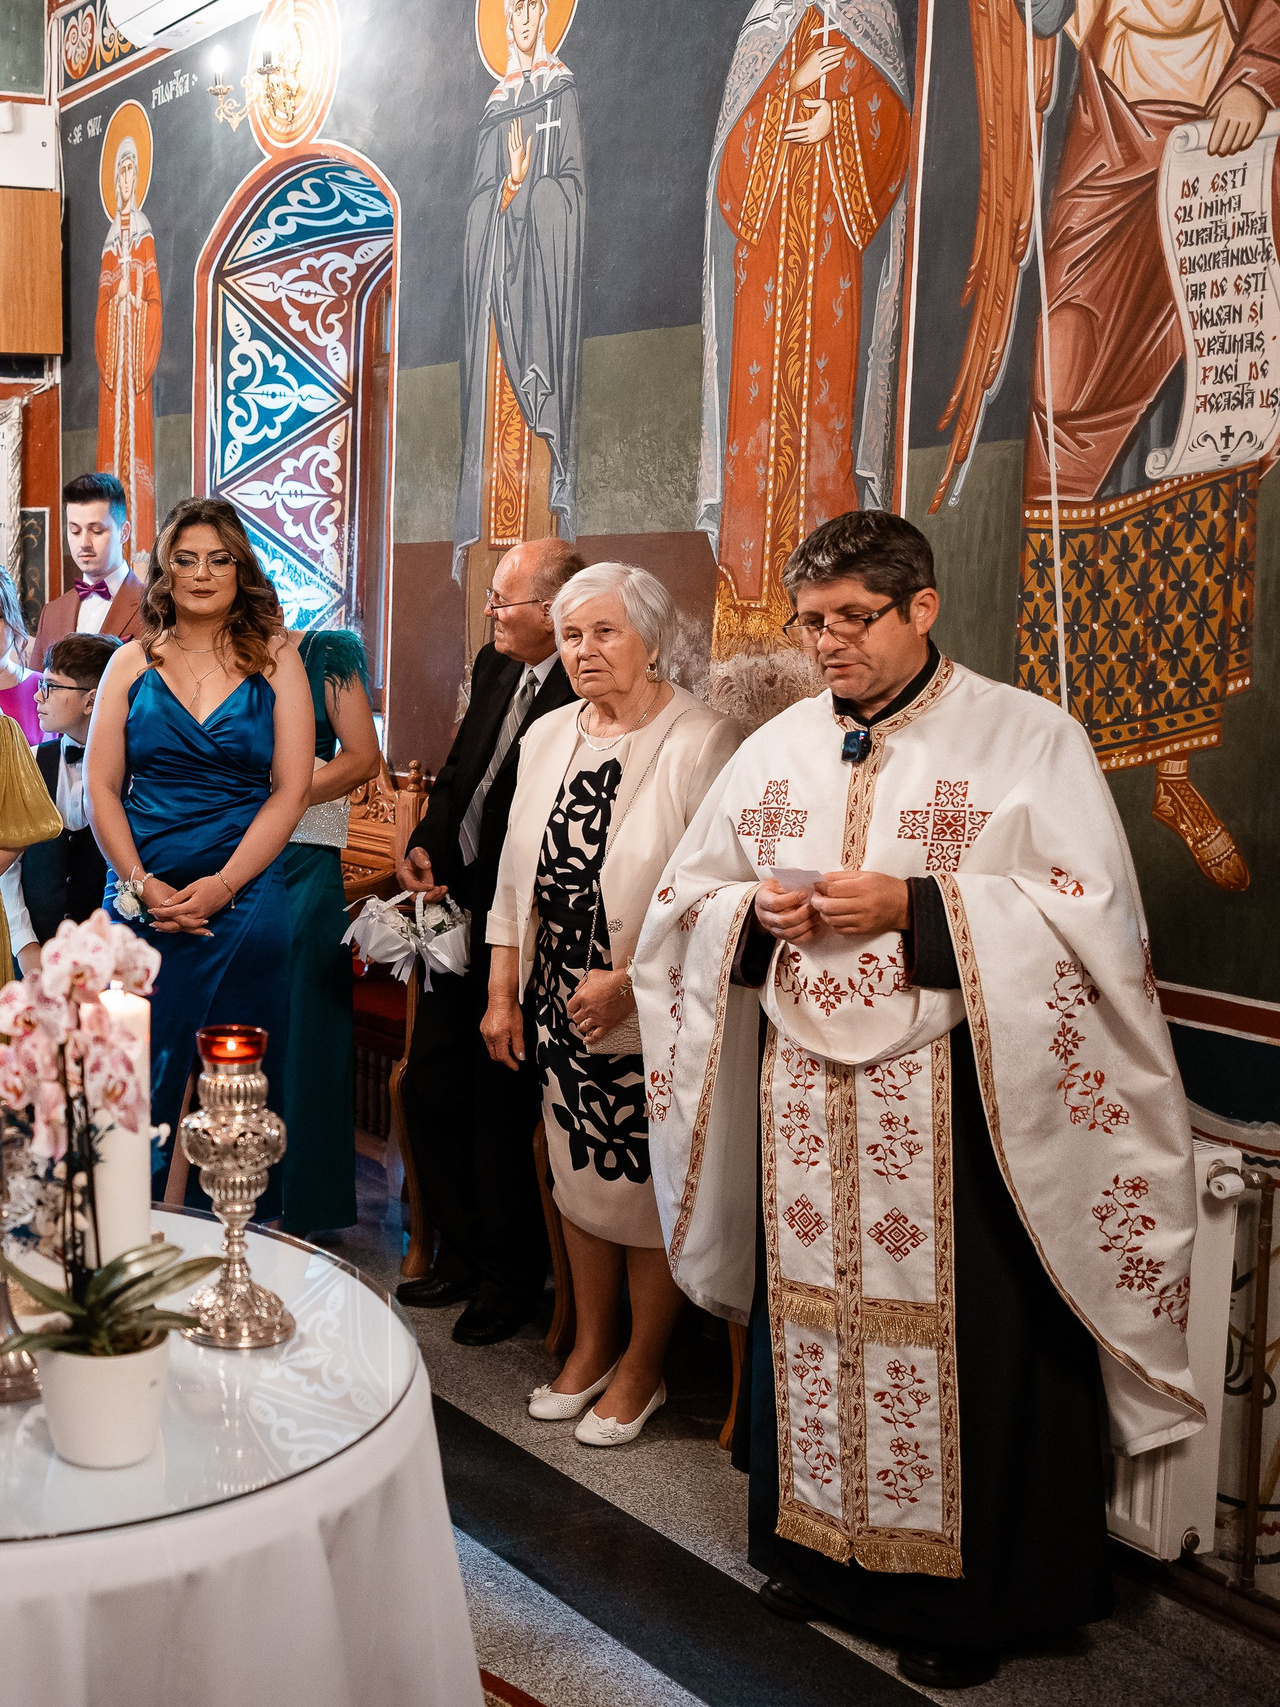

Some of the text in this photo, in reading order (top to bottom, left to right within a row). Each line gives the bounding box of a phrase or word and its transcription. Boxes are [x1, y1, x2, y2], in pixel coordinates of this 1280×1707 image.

[1210, 278, 1228, 299] DE
[1189, 302, 1242, 330] VICLEAN
[1201, 358, 1269, 385] FUGI DE
